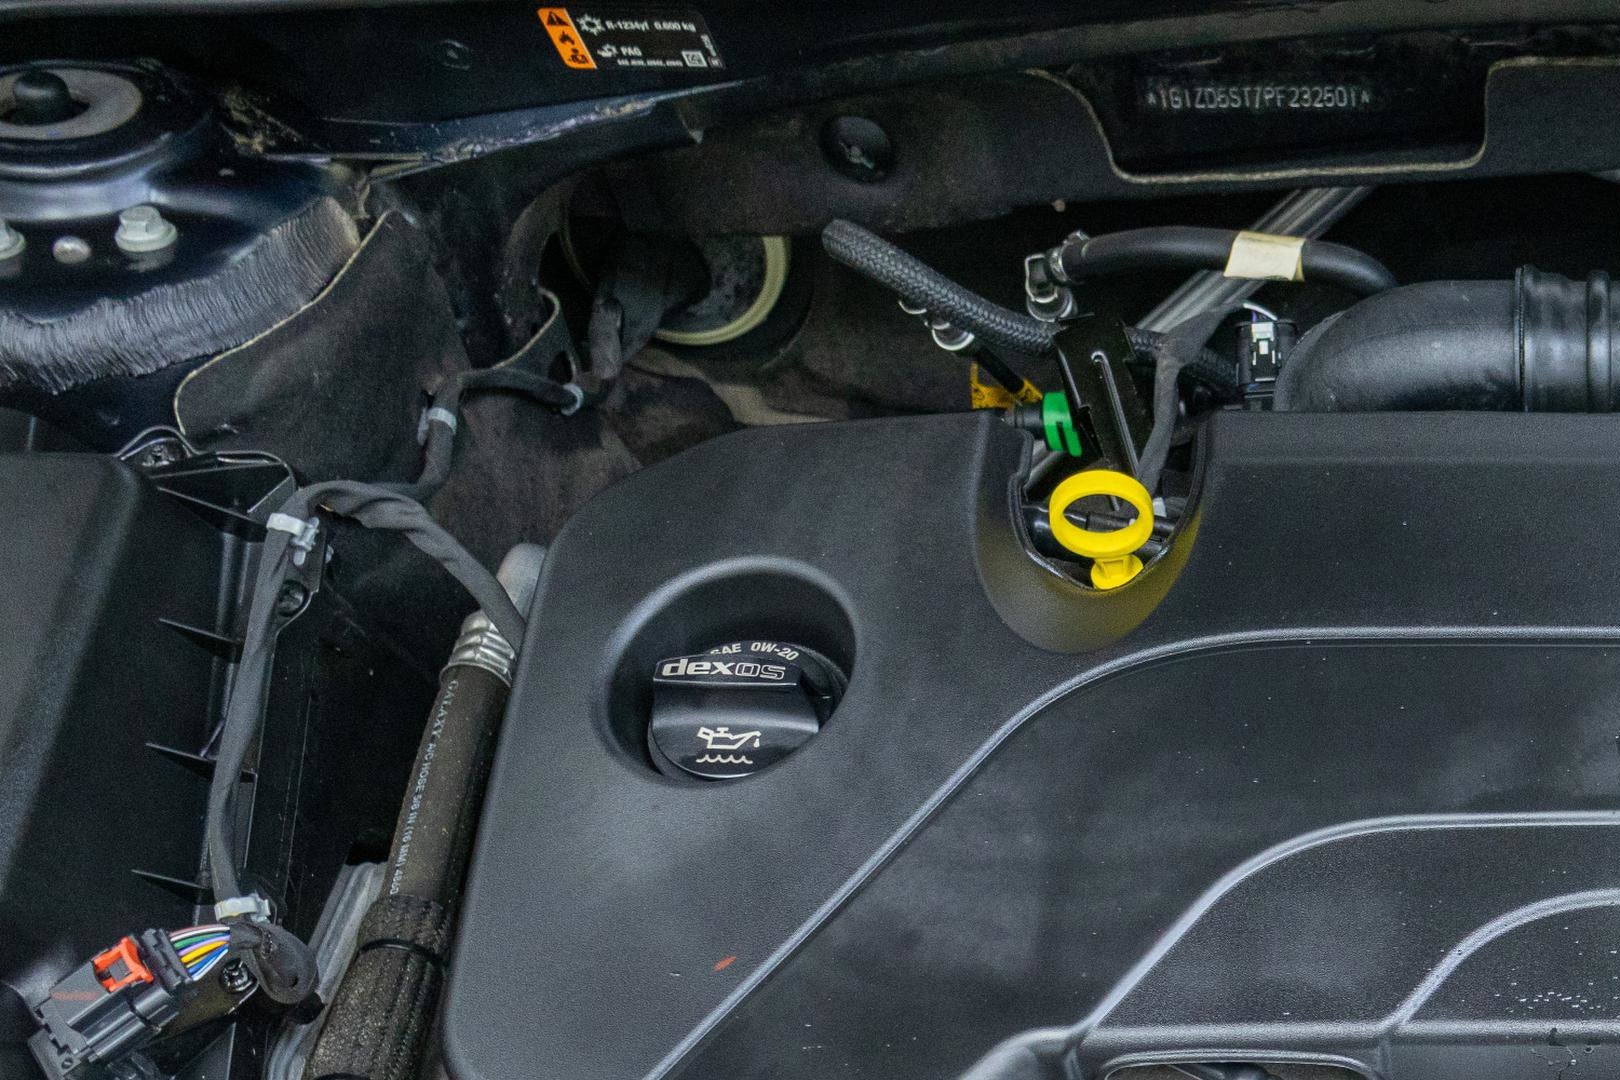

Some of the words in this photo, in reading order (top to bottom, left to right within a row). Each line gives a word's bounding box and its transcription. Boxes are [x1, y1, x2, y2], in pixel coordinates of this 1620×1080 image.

[750, 642, 799, 661] 0W-20
[662, 658, 786, 680] dexos
[431, 680, 459, 738] GALAXY
